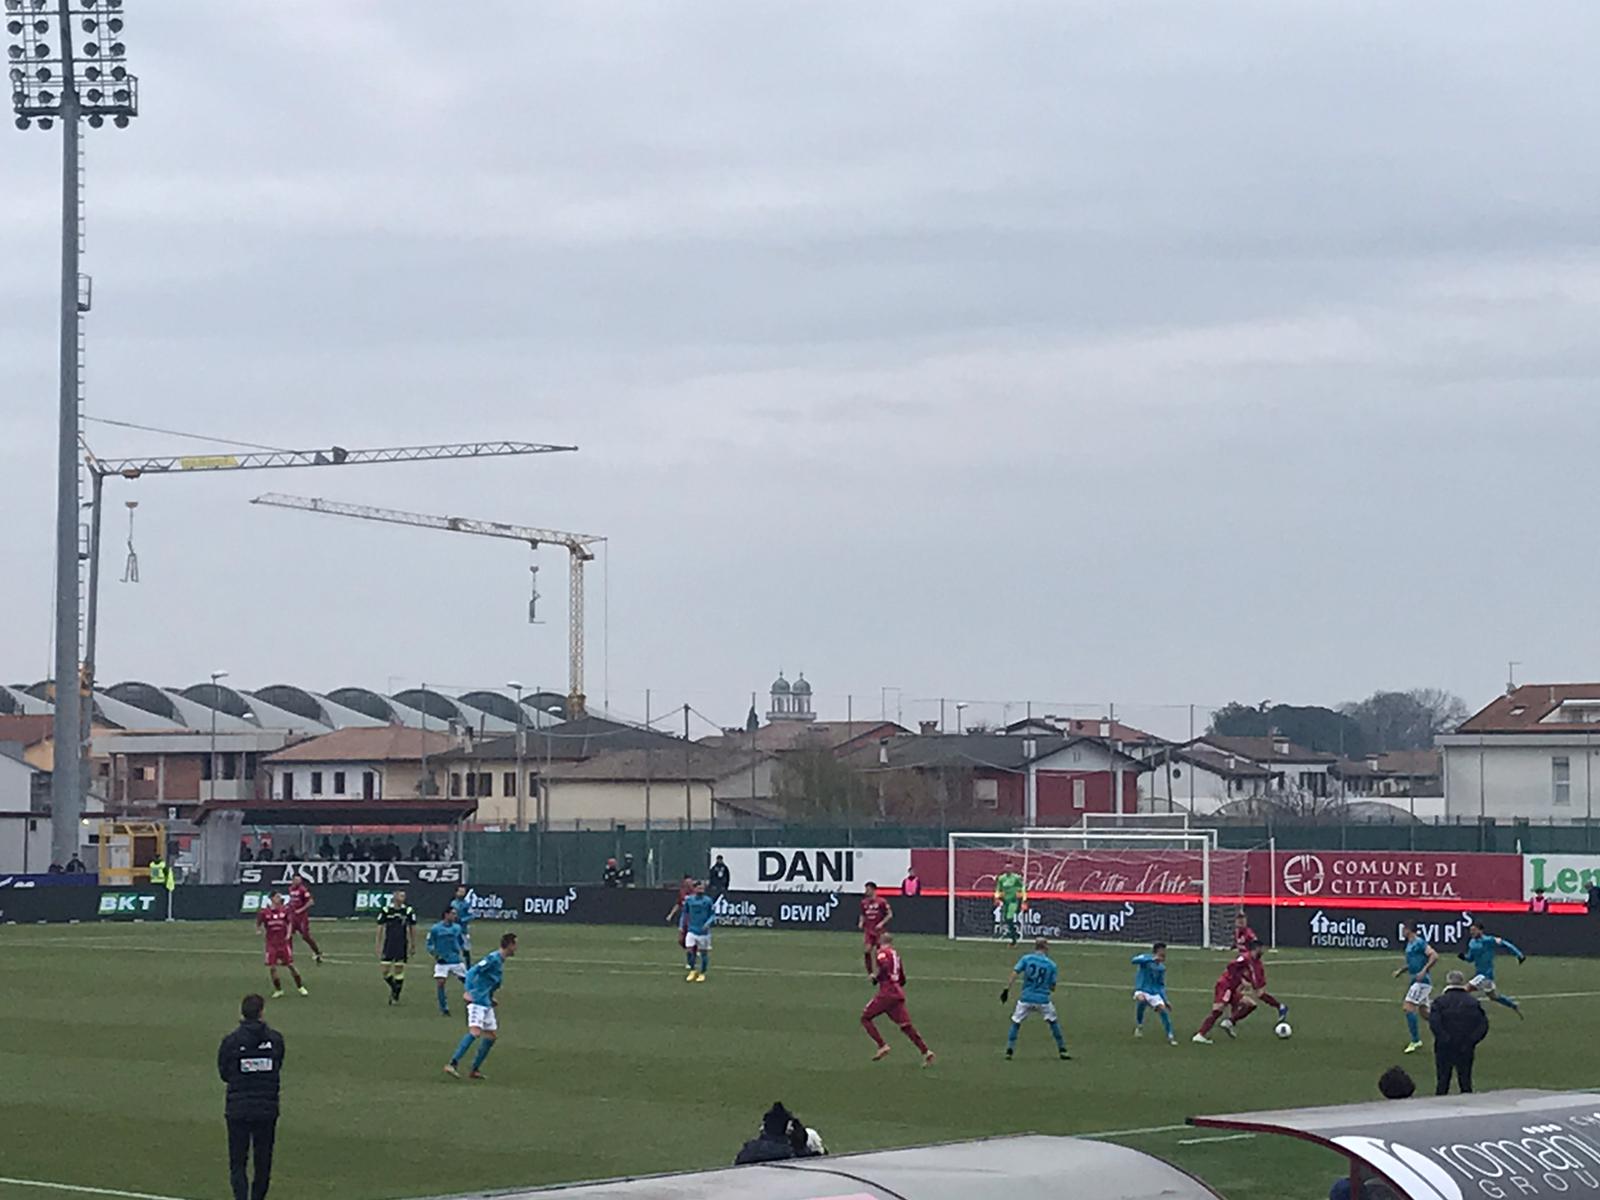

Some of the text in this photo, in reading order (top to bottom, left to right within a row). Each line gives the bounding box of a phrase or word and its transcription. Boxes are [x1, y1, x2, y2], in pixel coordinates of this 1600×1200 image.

[758, 851, 854, 882] DANI
[1333, 860, 1458, 877] COMUNE DI
[1332, 880, 1456, 896] CITTADELLA
[100, 896, 155, 910] BKT
[355, 893, 395, 908] BKT
[524, 897, 554, 914] DEVI
[780, 905, 813, 922] DEVI
[1069, 913, 1105, 931] DEVI
[1312, 935, 1389, 948] ristrutturare
